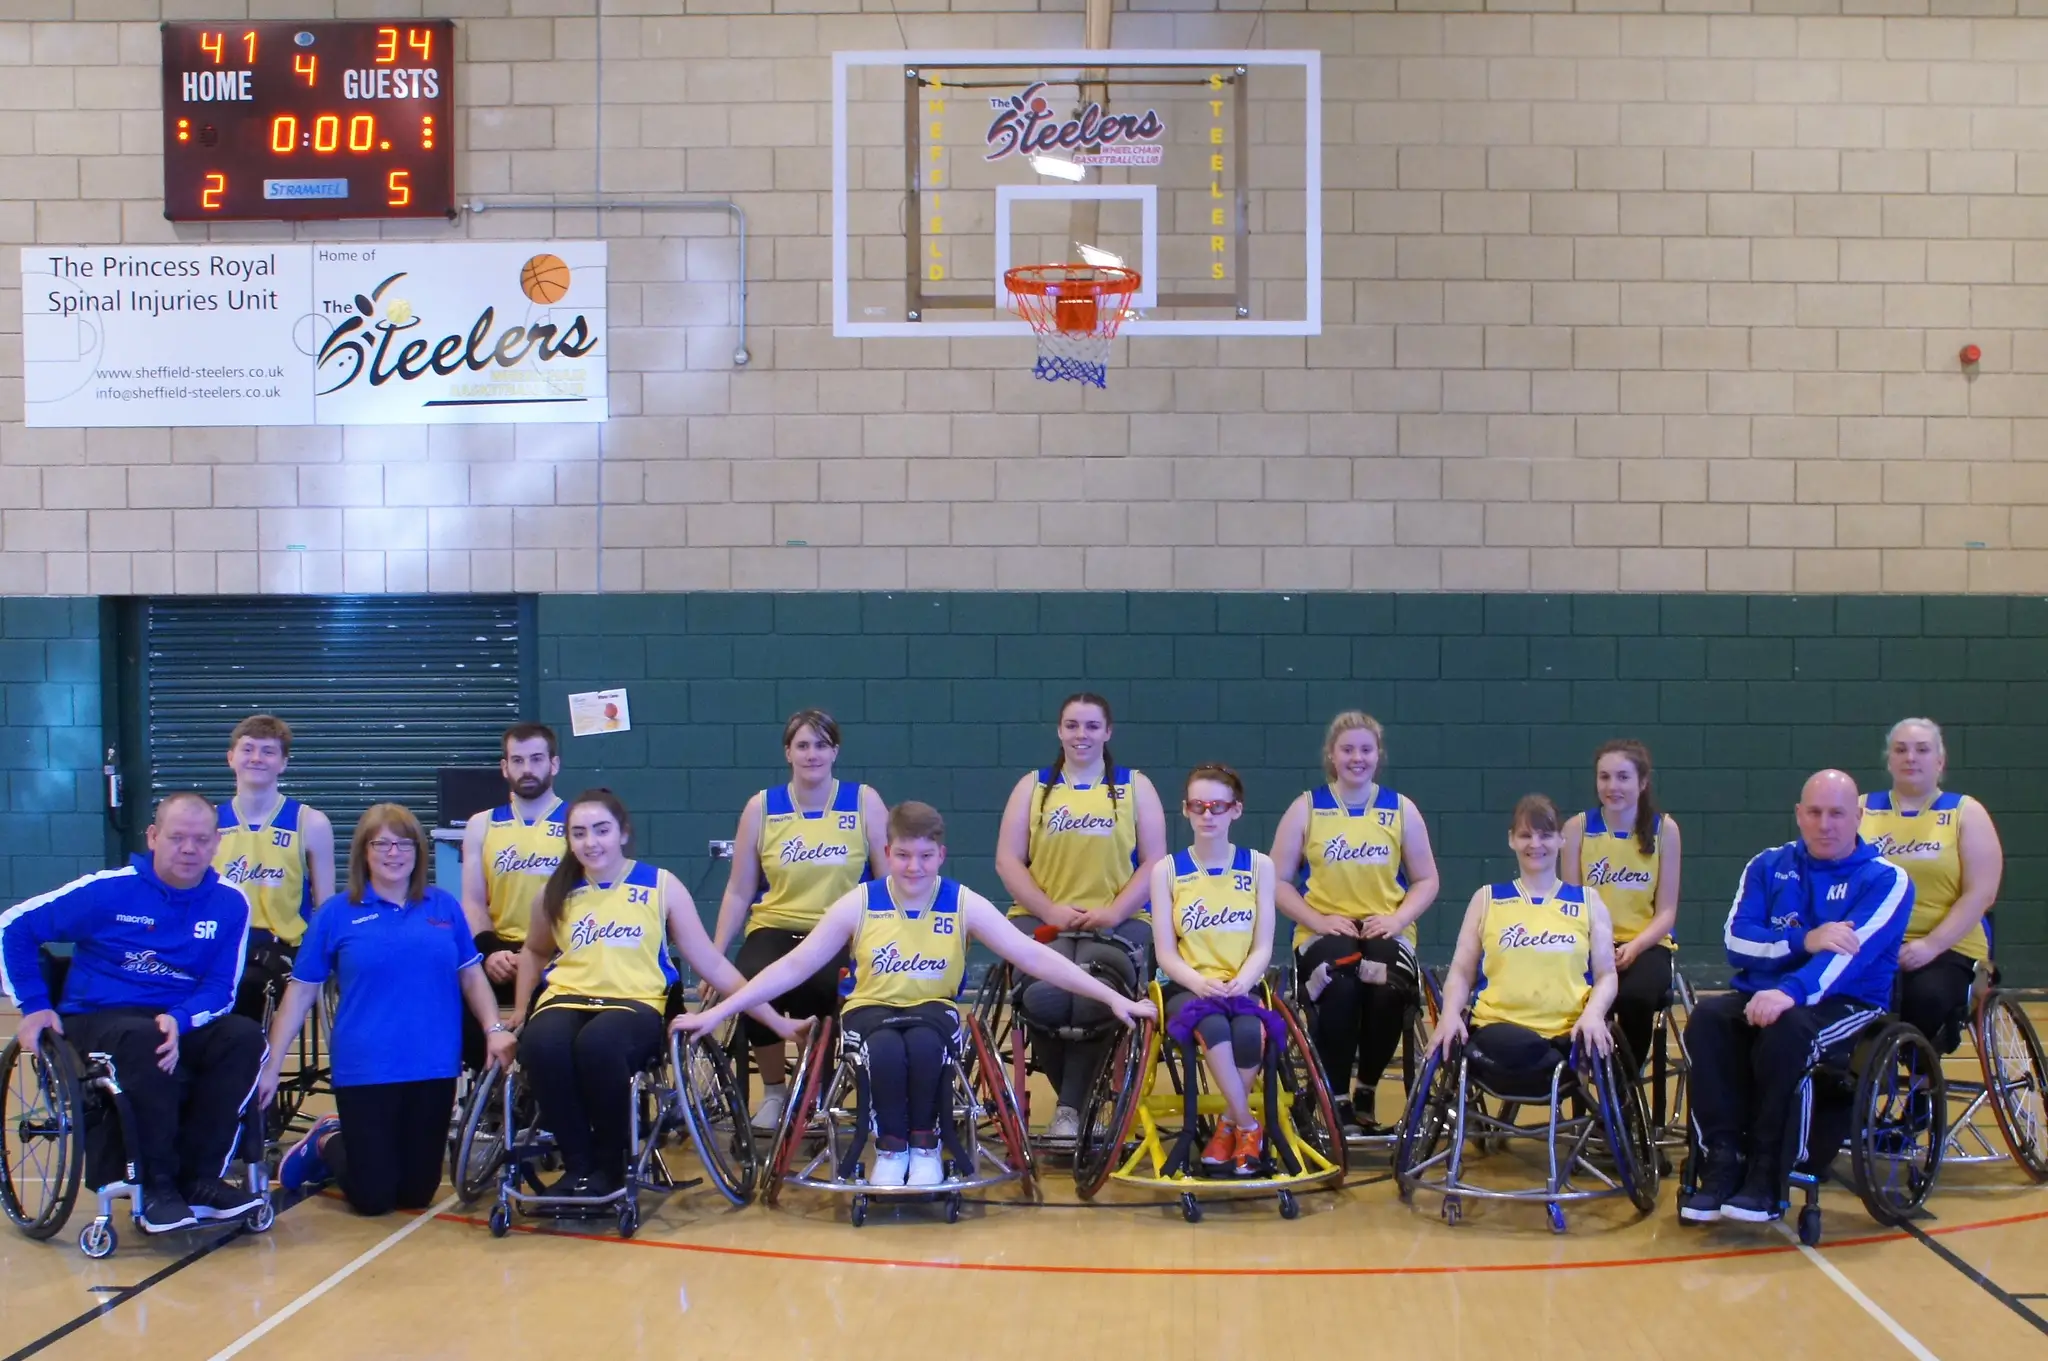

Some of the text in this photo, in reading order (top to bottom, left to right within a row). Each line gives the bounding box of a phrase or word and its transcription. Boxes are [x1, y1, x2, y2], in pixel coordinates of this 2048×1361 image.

[202, 31, 255, 63] 41
[376, 28, 432, 62] 34
[295, 55, 316, 86] 4
[183, 71, 253, 101] HOME
[344, 68, 439, 99] GUESTS
[992, 99, 1010, 108] The
[986, 102, 1165, 161] Steelers
[1134, 155, 1159, 164] CLUB
[1209, 73, 1225, 279] STEELERS
[203, 174, 224, 208] 2
[387, 171, 410, 205] 5
[319, 249, 376, 261] Home of
[49, 254, 275, 282] The Princess Royal
[48, 289, 279, 317] Spinal Injuries Unit
[323, 301, 353, 314] The
[316, 305, 599, 396] Steelers
[96, 366, 285, 379] www.sheffield-steelers.co.uk
[95, 386, 281, 401] info@sheffield-steelers.co.uk
[546, 823, 565, 838] 38
[838, 815, 856, 830] 29
[1047, 812, 1115, 836] Steelers
[1378, 811, 1395, 827] 37
[1936, 812, 1952, 826] 31
[272, 831, 292, 848] 30
[780, 842, 849, 866] Steelers
[1323, 841, 1390, 864] Steelers
[1232, 874, 1253, 892] 32
[1826, 882, 1849, 901] KH
[627, 887, 649, 905] 34
[116, 914, 155, 926] macron
[1181, 905, 1254, 934] Steelers
[1559, 902, 1580, 918] 40
[193, 920, 218, 940] SR
[571, 920, 644, 951] Steelers
[933, 916, 954, 935] 26
[1498, 929, 1577, 953] Steelers
[871, 952, 948, 977] Steelers
